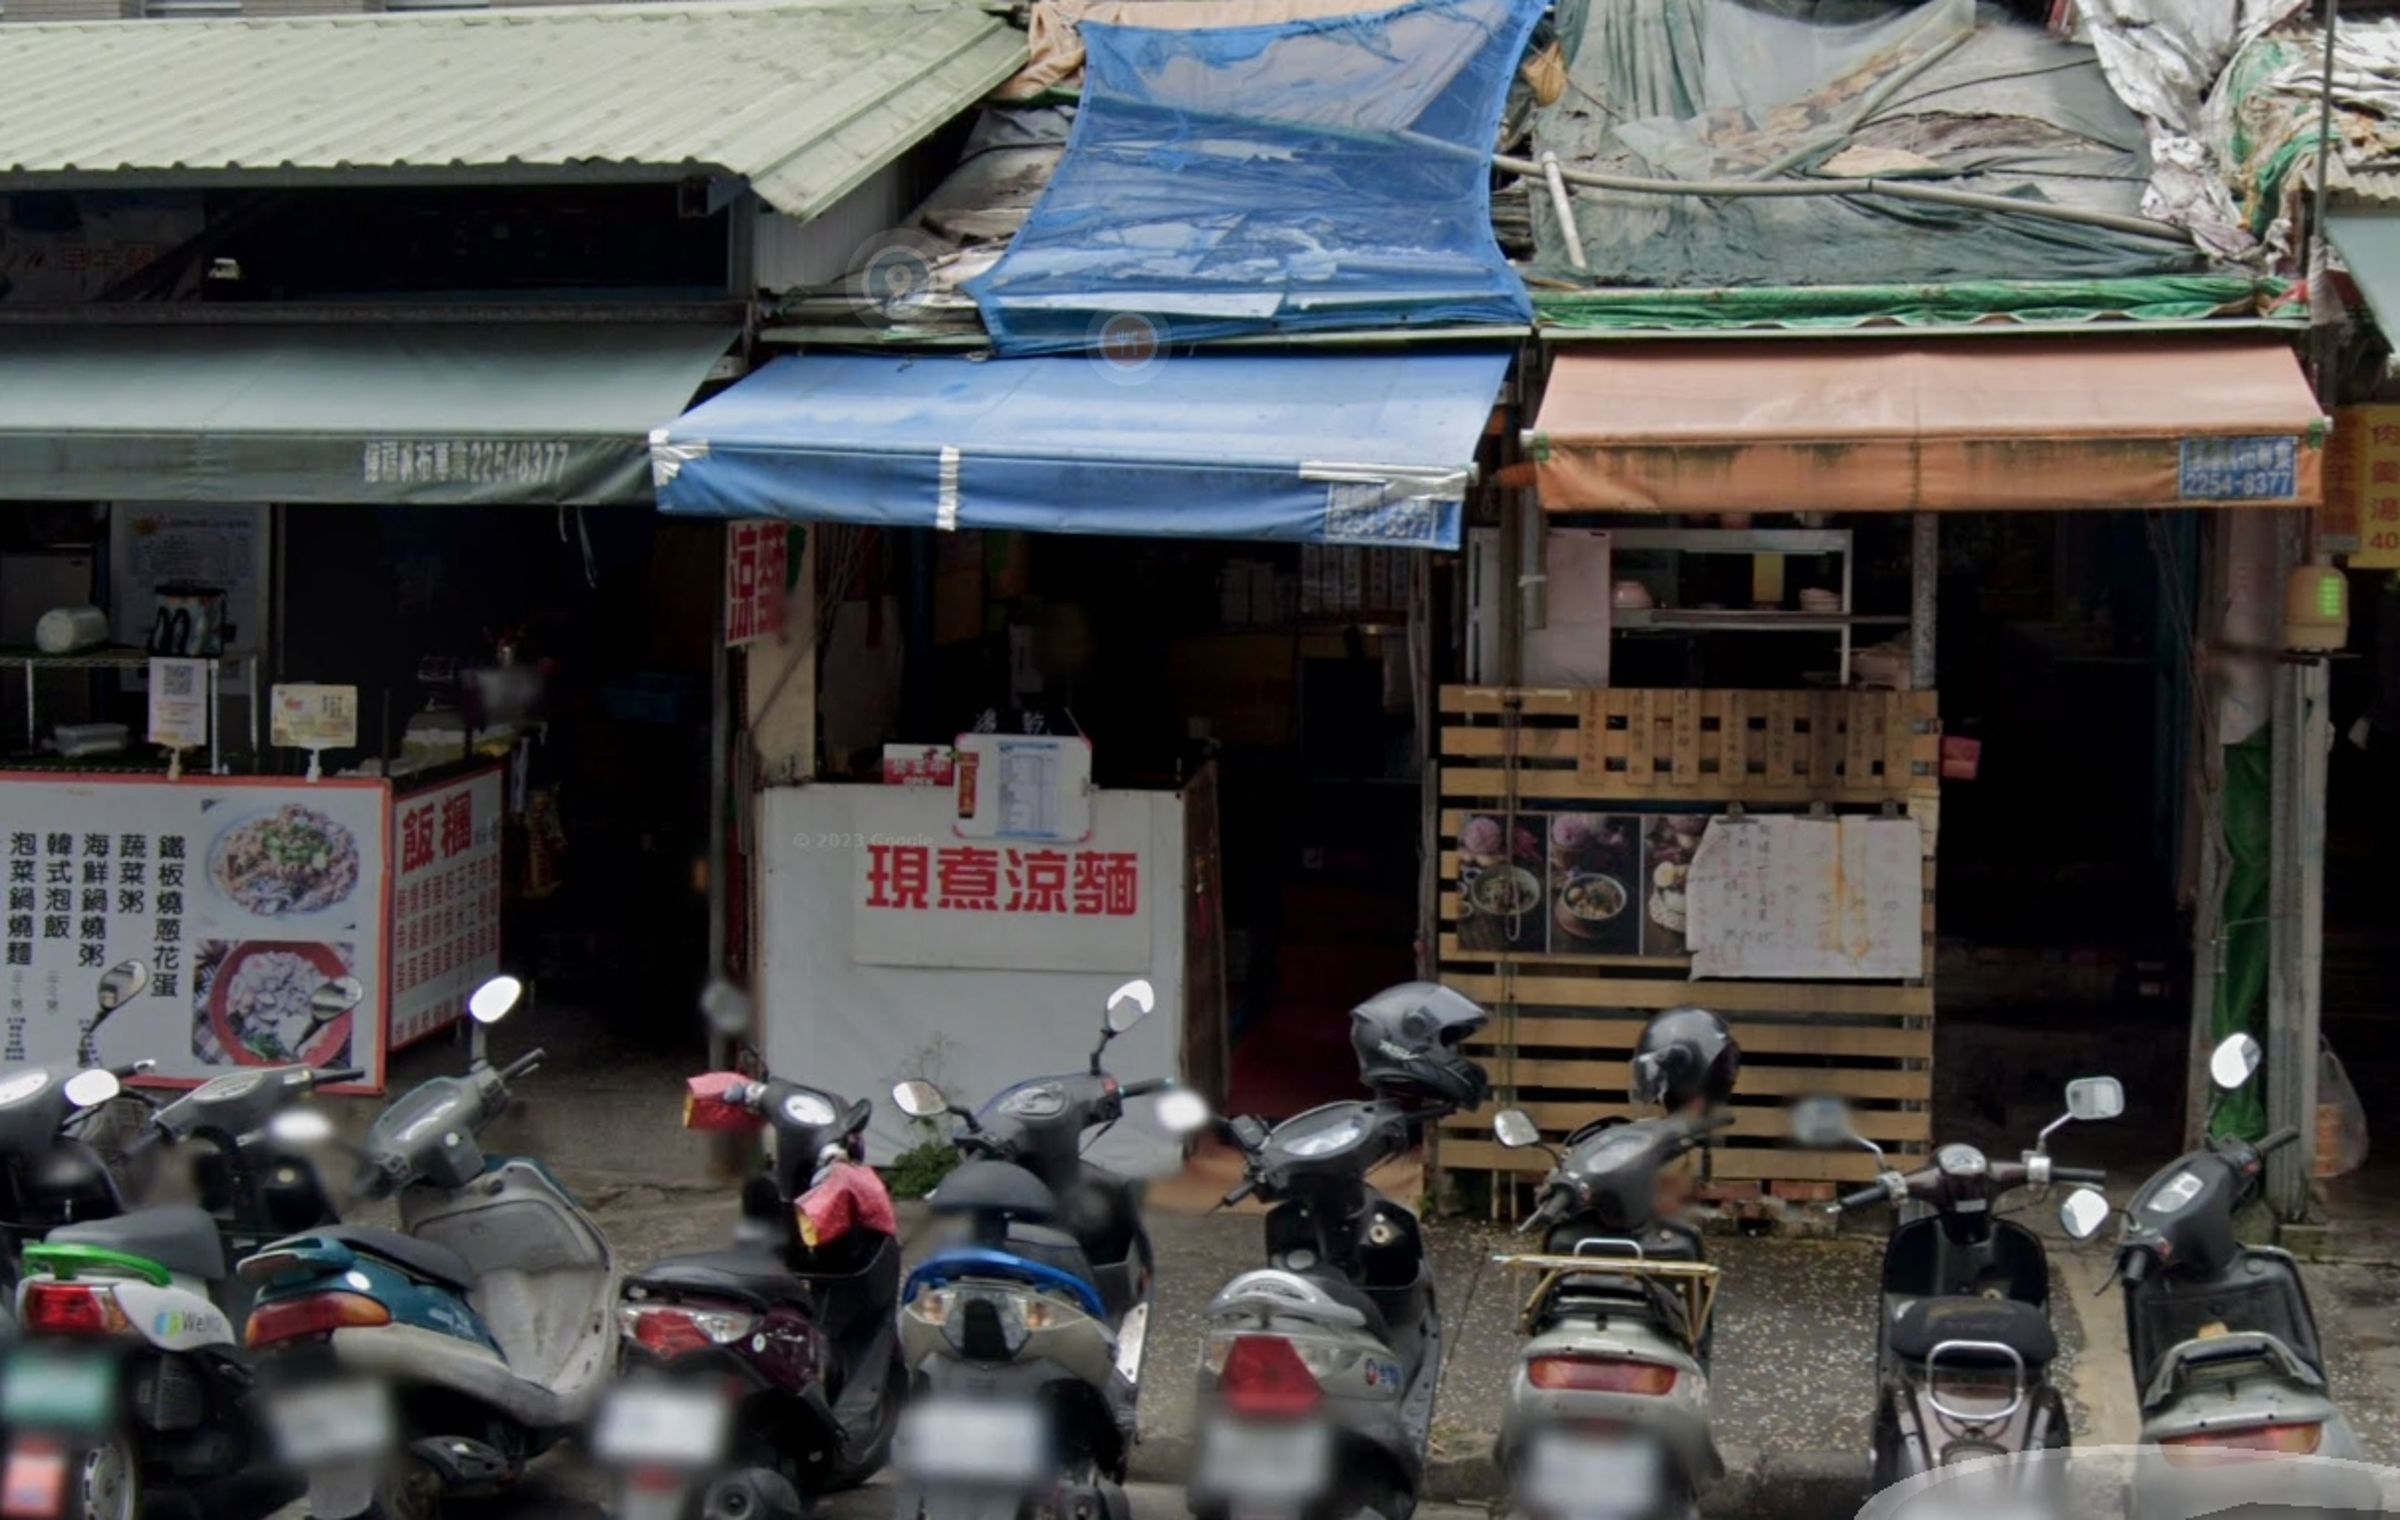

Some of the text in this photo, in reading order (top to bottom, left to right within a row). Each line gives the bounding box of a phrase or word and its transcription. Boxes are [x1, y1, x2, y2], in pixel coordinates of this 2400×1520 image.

[2370, 531, 2399, 550] 40
[117, 834, 147, 914] 蔬菜粥
[402, 790, 473, 876] 飯糰
[43, 832, 73, 940] 韓式泡飯
[78, 833, 110, 968] 海鮮鍋燒粥
[866, 844, 1138, 917] 現煮涼麵
